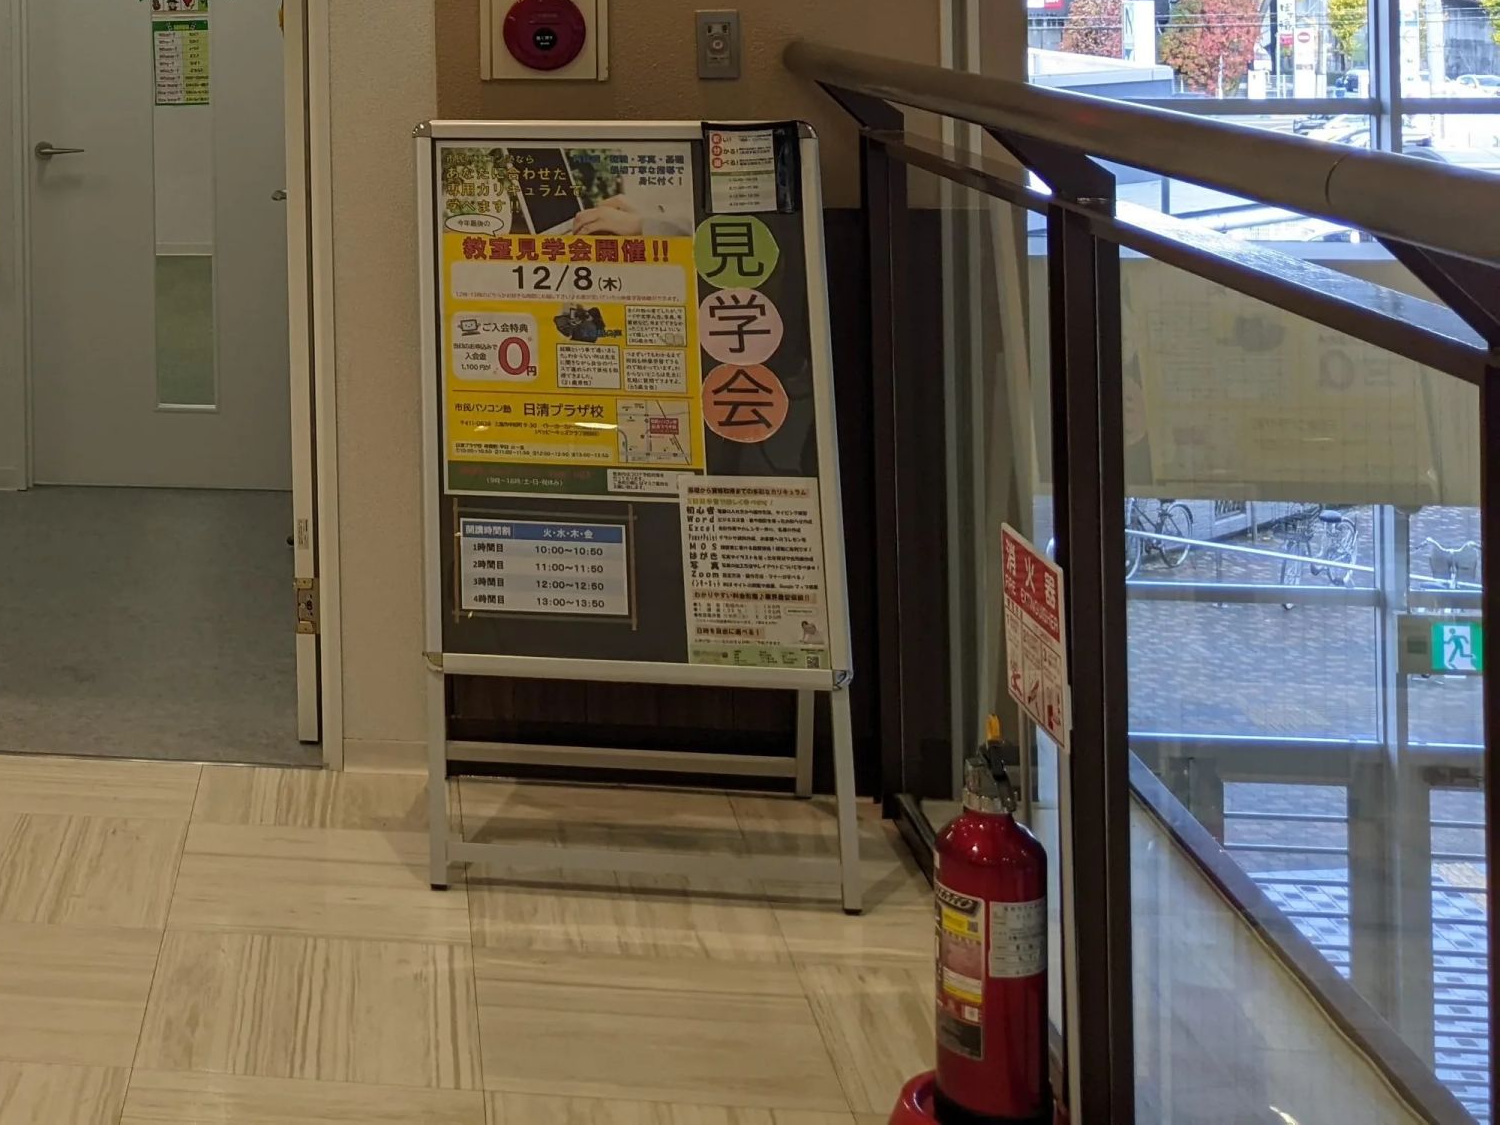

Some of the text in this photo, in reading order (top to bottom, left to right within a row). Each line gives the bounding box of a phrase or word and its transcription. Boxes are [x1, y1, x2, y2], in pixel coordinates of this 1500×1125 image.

[461, 235, 670, 263] 教室見学会開催!!
[511, 264, 623, 293] 12/8 (木)
[481, 323, 529, 334] ご入会特典
[706, 221, 775, 431] 見学会
[464, 352, 487, 361] 入会金
[497, 336, 531, 376] 0
[526, 365, 538, 377] 円
[454, 402, 605, 419] 市民パソコン塾 日清プラザ校
[472, 542, 604, 557] 1時間目 10:00〜10:50
[472, 559, 604, 574] 2時間目 11:00〜11:50
[472, 576, 605, 592] 3時間目 12:00〜12:50
[472, 594, 605, 609] 4時間目 13:00〜13:50
